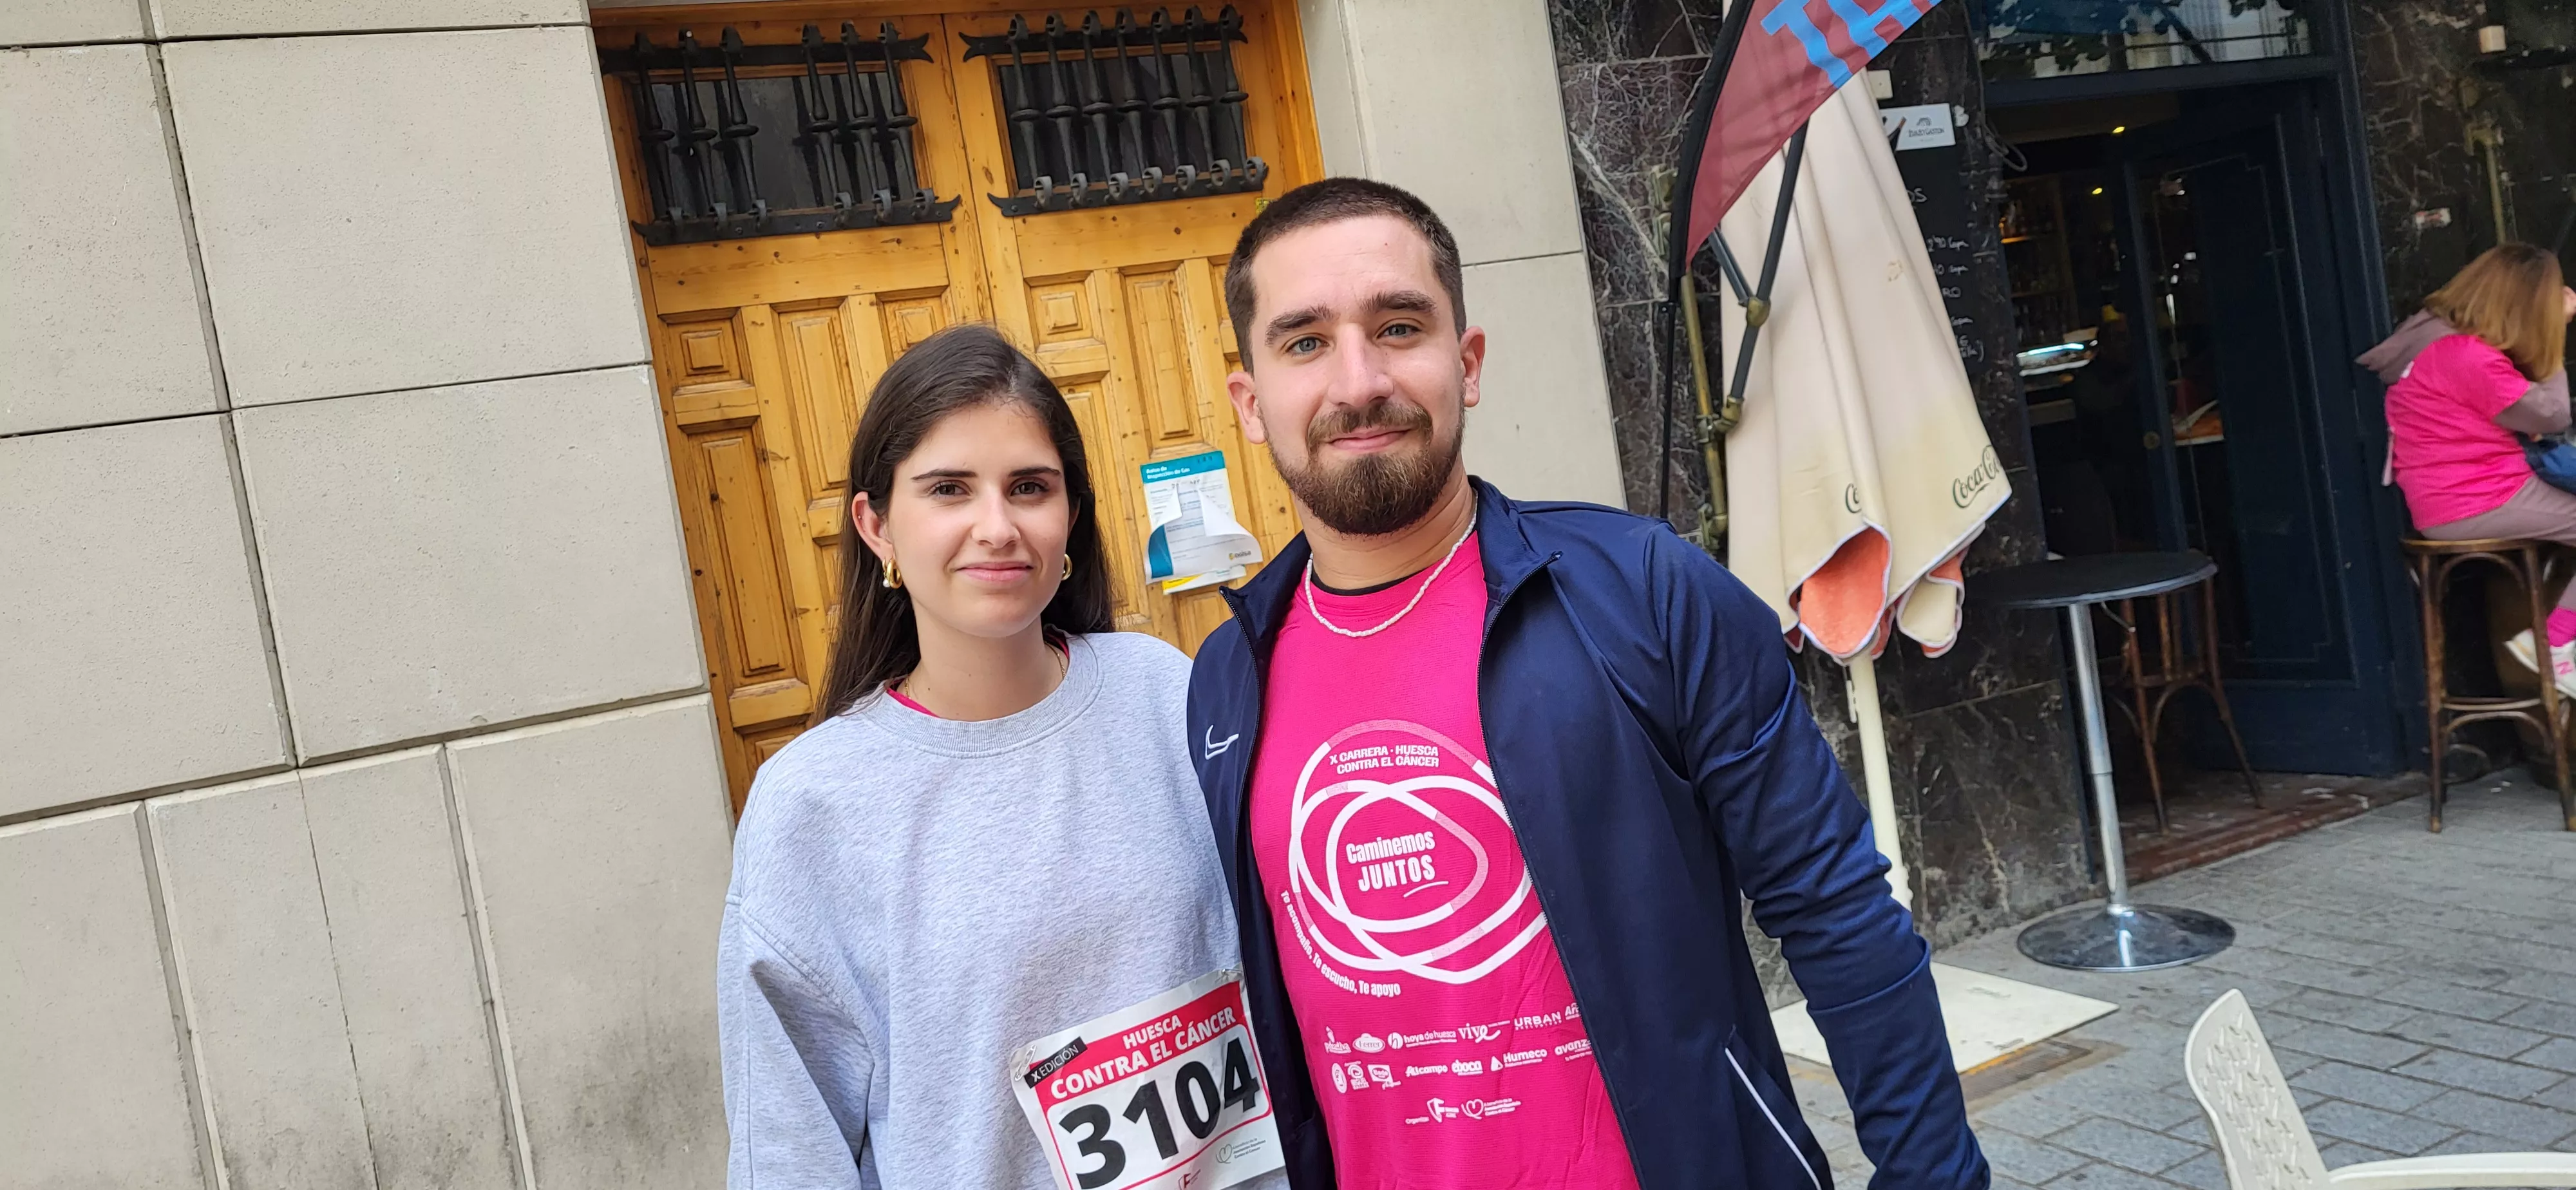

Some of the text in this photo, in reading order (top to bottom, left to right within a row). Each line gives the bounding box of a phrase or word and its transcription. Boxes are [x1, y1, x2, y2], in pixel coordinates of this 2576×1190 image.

[1329, 745, 1438, 765] X CARRERA HUESCA
[1337, 754, 1439, 775] CONTRA EL CÁNCER
[1346, 831, 1435, 864] Caminemos
[1358, 855, 1435, 892] JUNTOS
[1281, 890, 1291, 903] Te
[1312, 952, 1322, 968] Te
[1358, 980, 1369, 995] Te
[1370, 983, 1401, 997] apoyo
[1122, 1014, 1182, 1050] HUESCA
[1404, 1033, 1425, 1044] hoya
[1458, 1023, 1501, 1043] vive
[1515, 1012, 1561, 1027] URBAN
[1031, 1044, 1079, 1082] X EDICIÓN
[1050, 1006, 1236, 1099] CONTRA EL CÁNCER
[1503, 1048, 1548, 1062] Humeco
[1059, 1037, 1260, 1190] 3104
